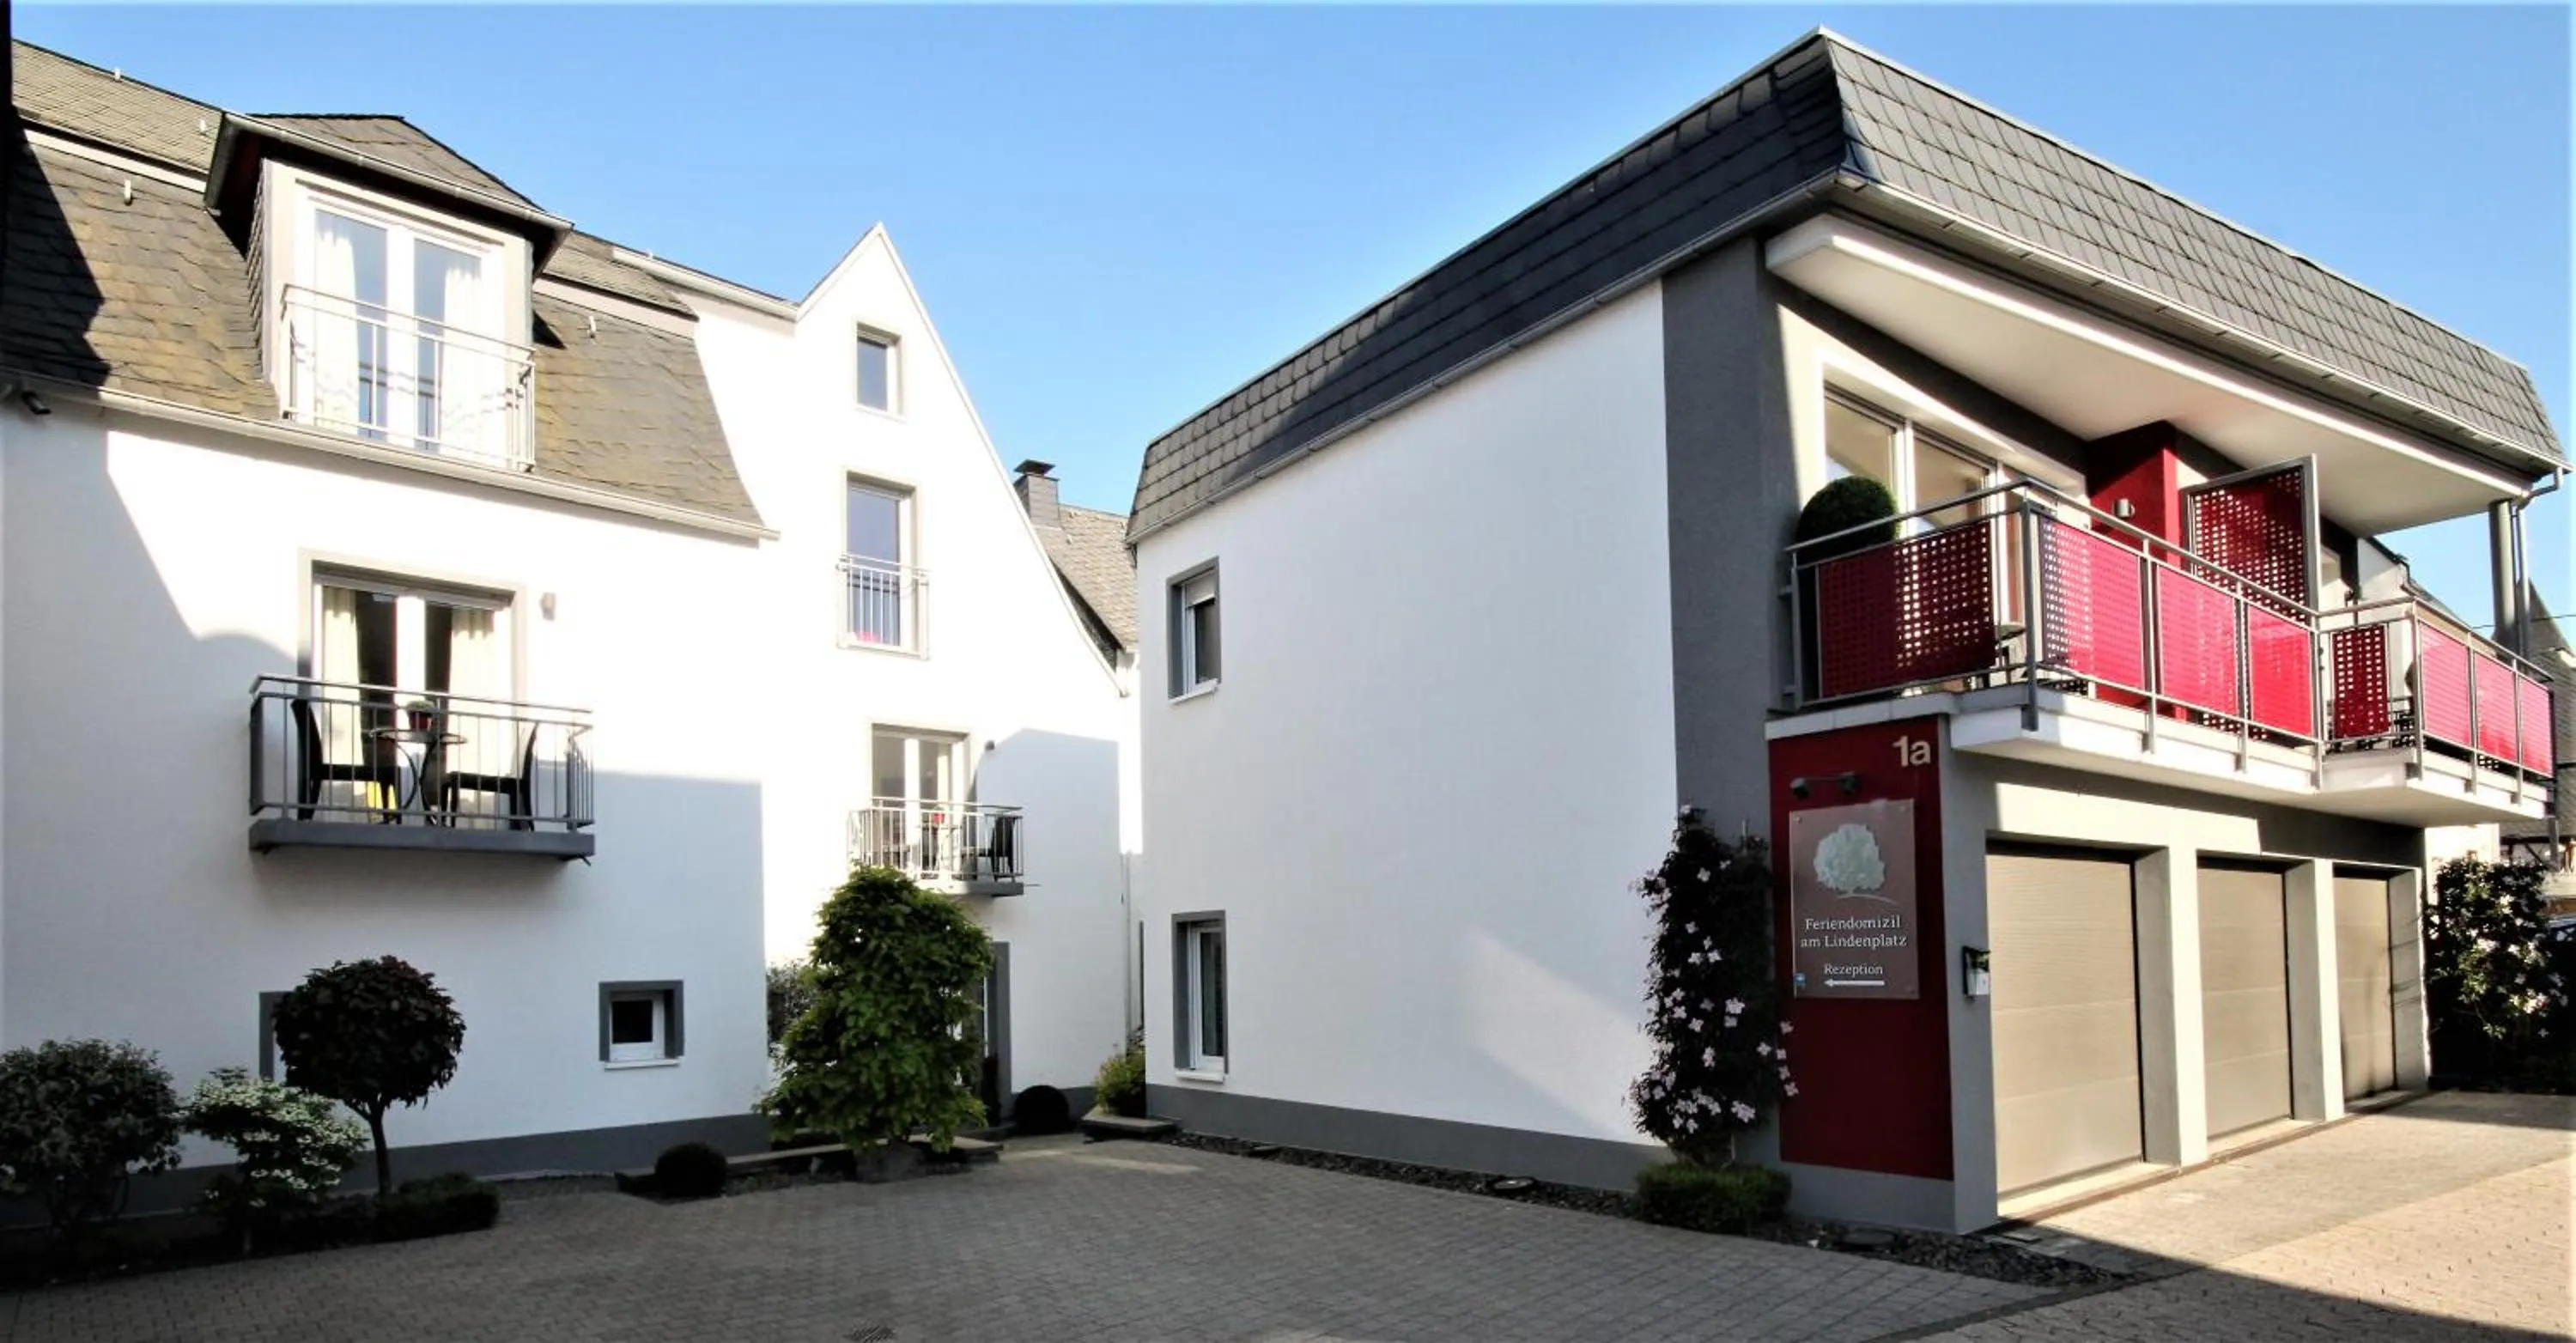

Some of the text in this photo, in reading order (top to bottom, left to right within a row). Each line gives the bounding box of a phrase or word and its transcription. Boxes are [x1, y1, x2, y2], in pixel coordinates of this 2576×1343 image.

[1892, 735, 1931, 767] 1a
[1805, 915, 1901, 930] Feriendomizil
[1801, 933, 1907, 951] am Lindenplatz
[1824, 963, 1883, 977] Rezeption
